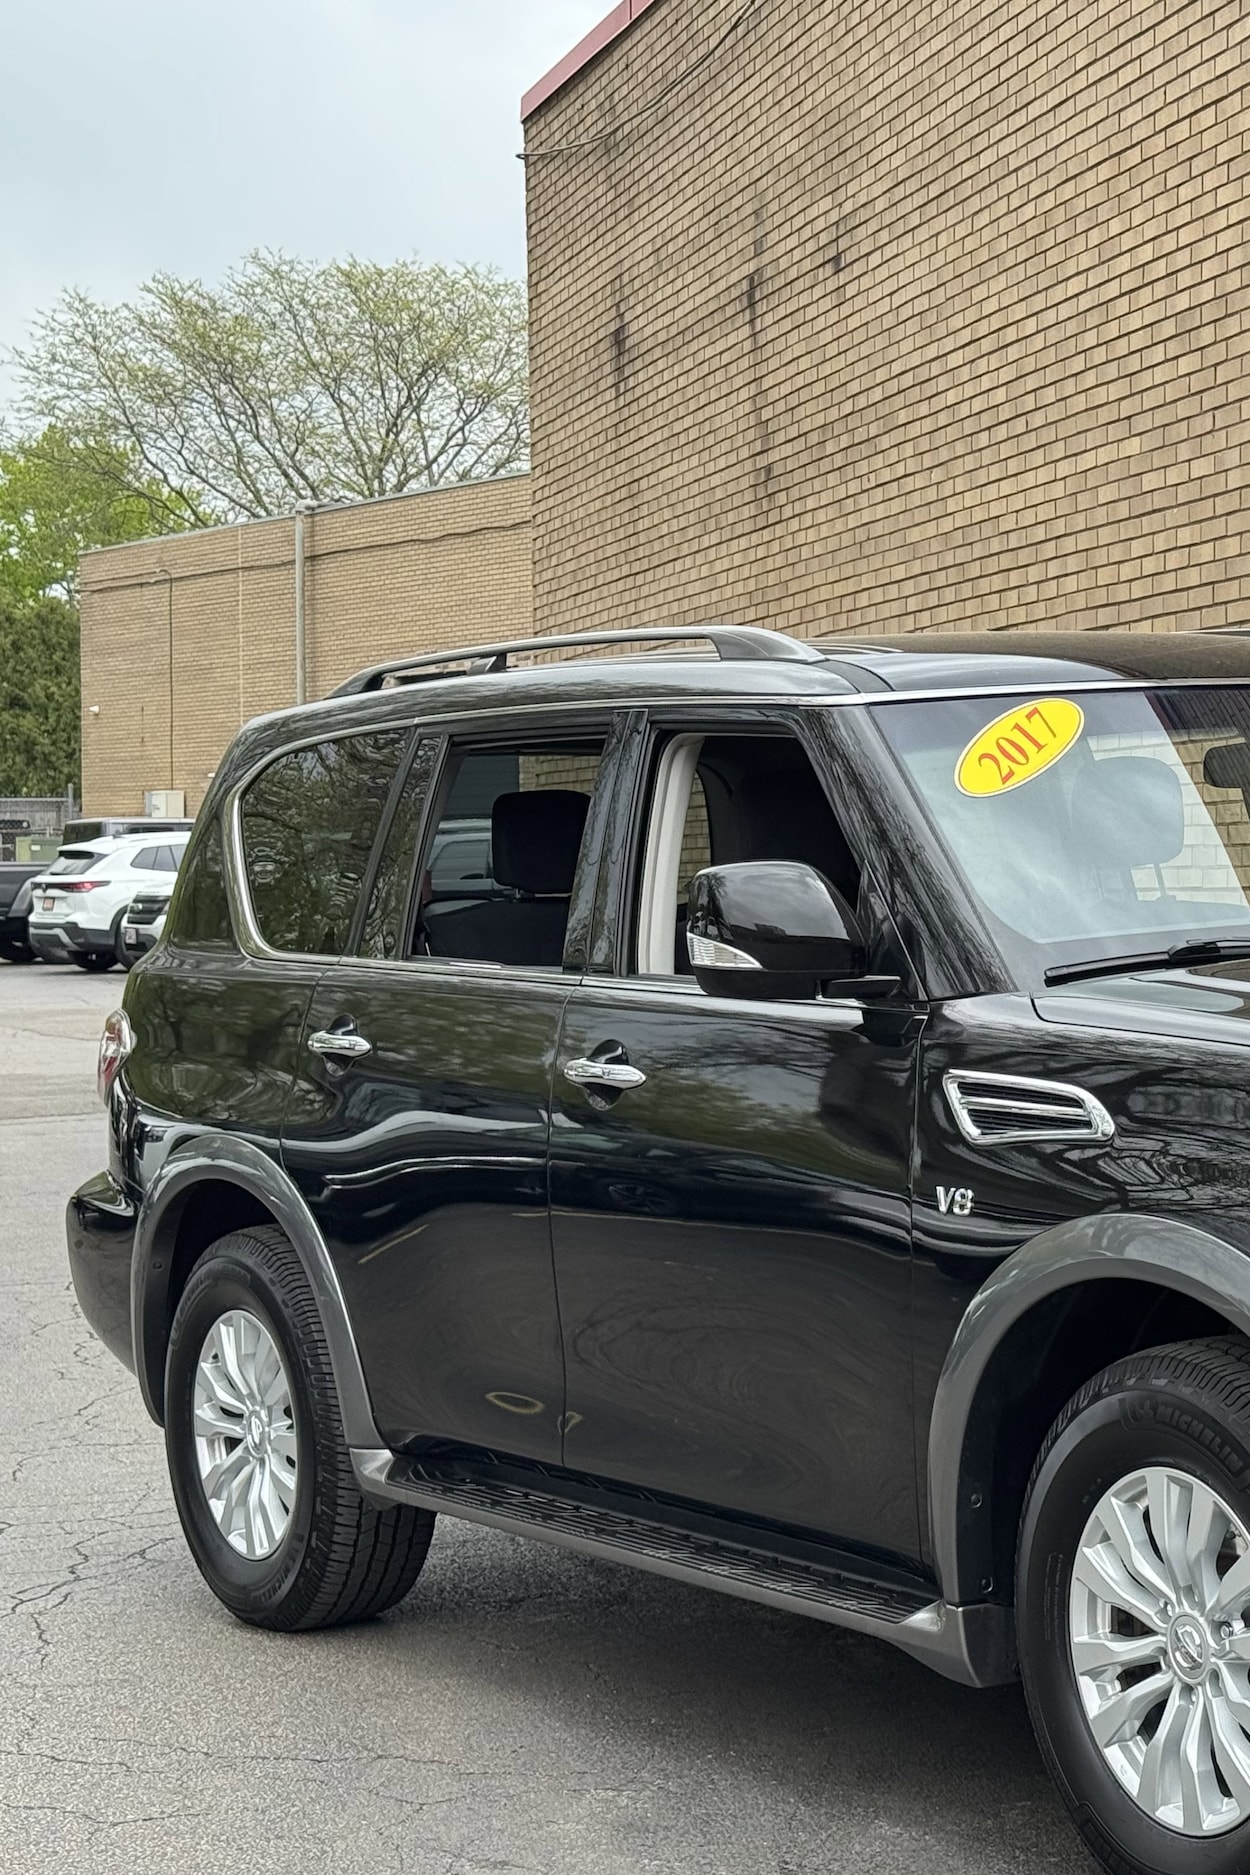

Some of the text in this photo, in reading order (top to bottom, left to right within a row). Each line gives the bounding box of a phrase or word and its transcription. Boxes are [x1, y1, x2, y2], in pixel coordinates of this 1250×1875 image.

[978, 706, 1057, 785] 2017
[936, 1186, 974, 1216] V8
[1156, 1404, 1245, 1478] MICHELIN
